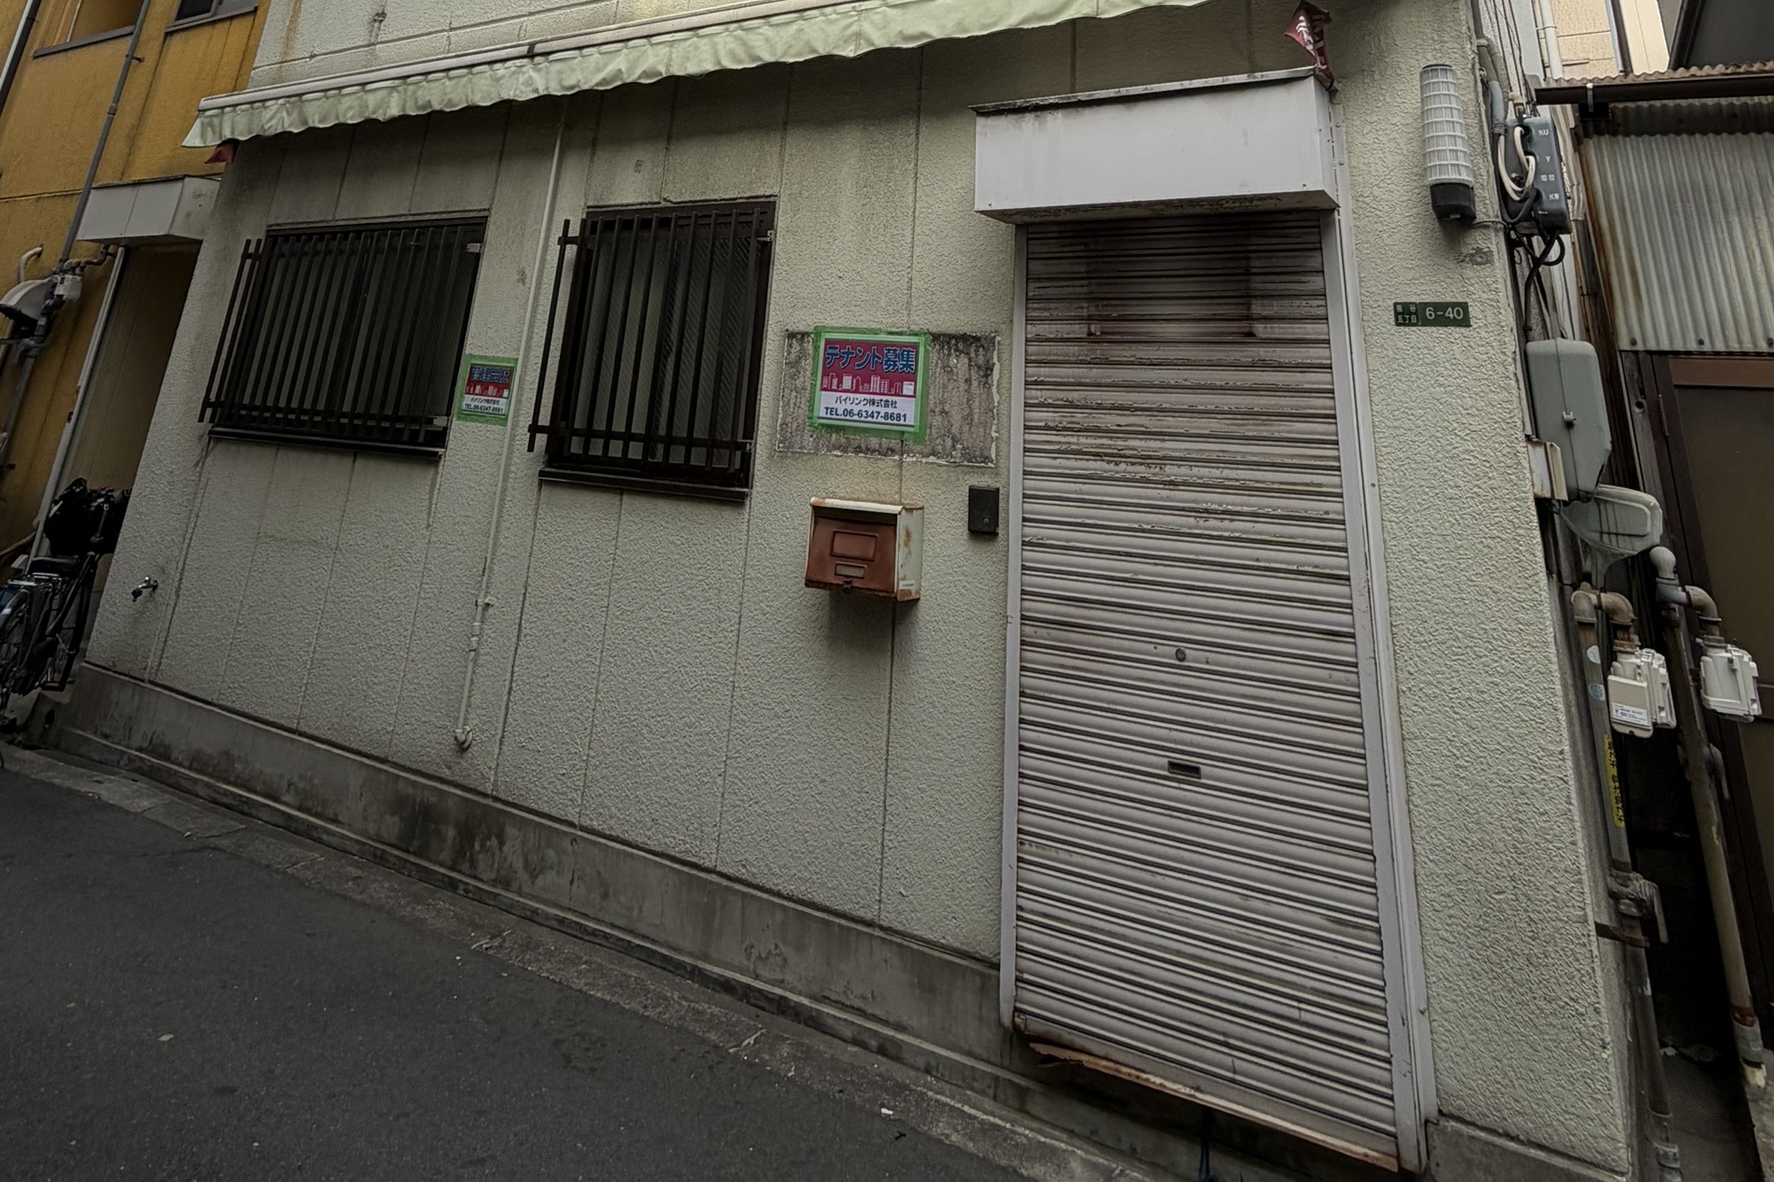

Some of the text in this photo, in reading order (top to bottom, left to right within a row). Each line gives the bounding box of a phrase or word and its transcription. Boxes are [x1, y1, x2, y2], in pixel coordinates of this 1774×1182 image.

[1397, 314, 1417, 324] 五丁目
[1425, 306, 1464, 320] 6-40
[825, 344, 916, 373] テナント募集
[824, 406, 907, 422] TEL.06-6347-8681
